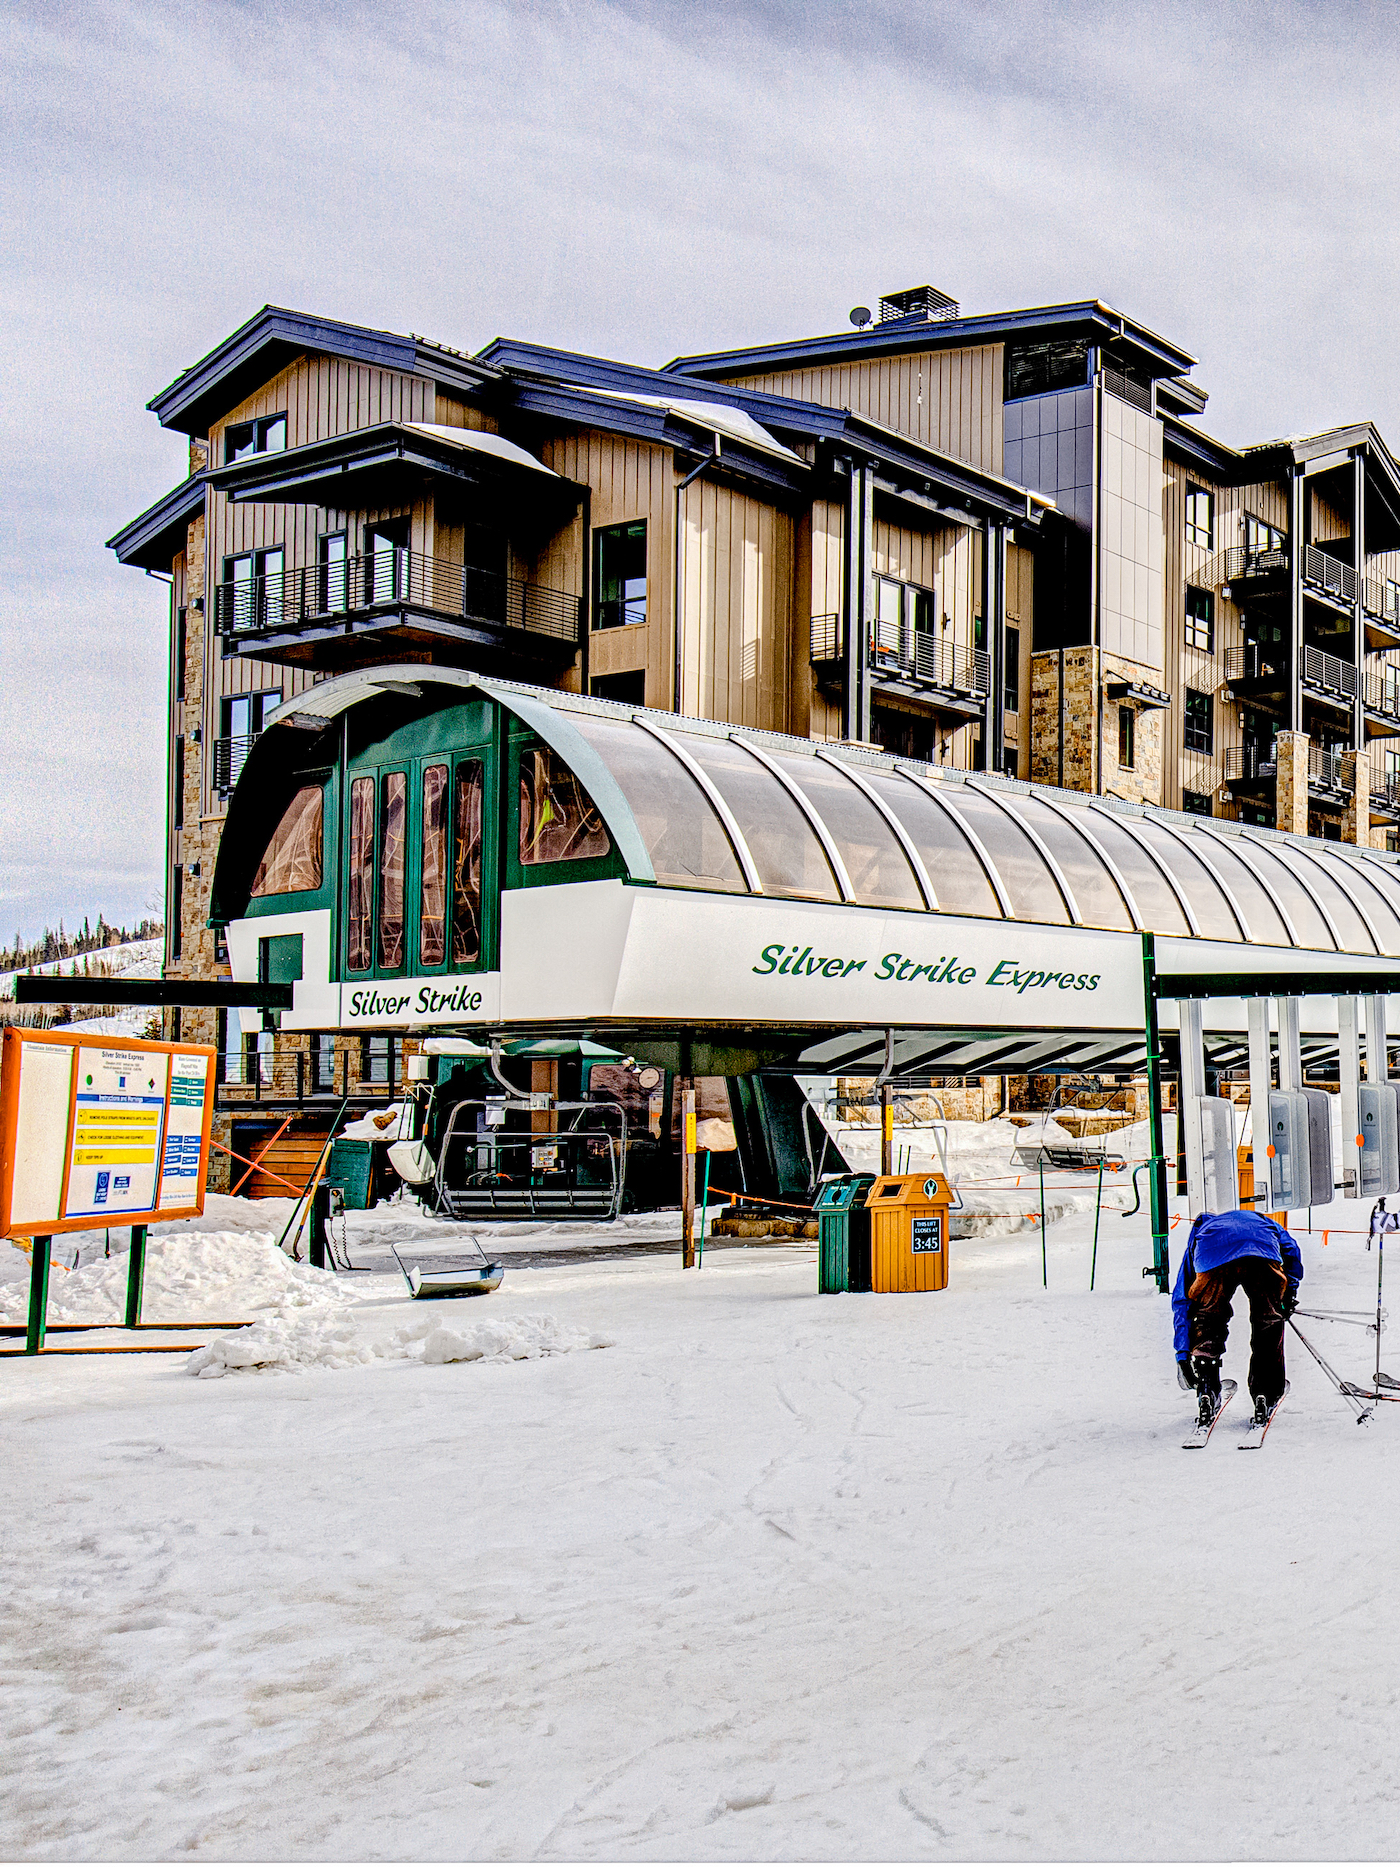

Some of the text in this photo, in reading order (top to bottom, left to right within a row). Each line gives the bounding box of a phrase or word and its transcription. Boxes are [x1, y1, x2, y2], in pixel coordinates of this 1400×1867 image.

[752, 944, 1101, 994] Silver Strike Express
[349, 984, 483, 1017] Silver Strike
[115, 1051, 128, 1059] Strike
[914, 1237, 938, 1250] 3:45
